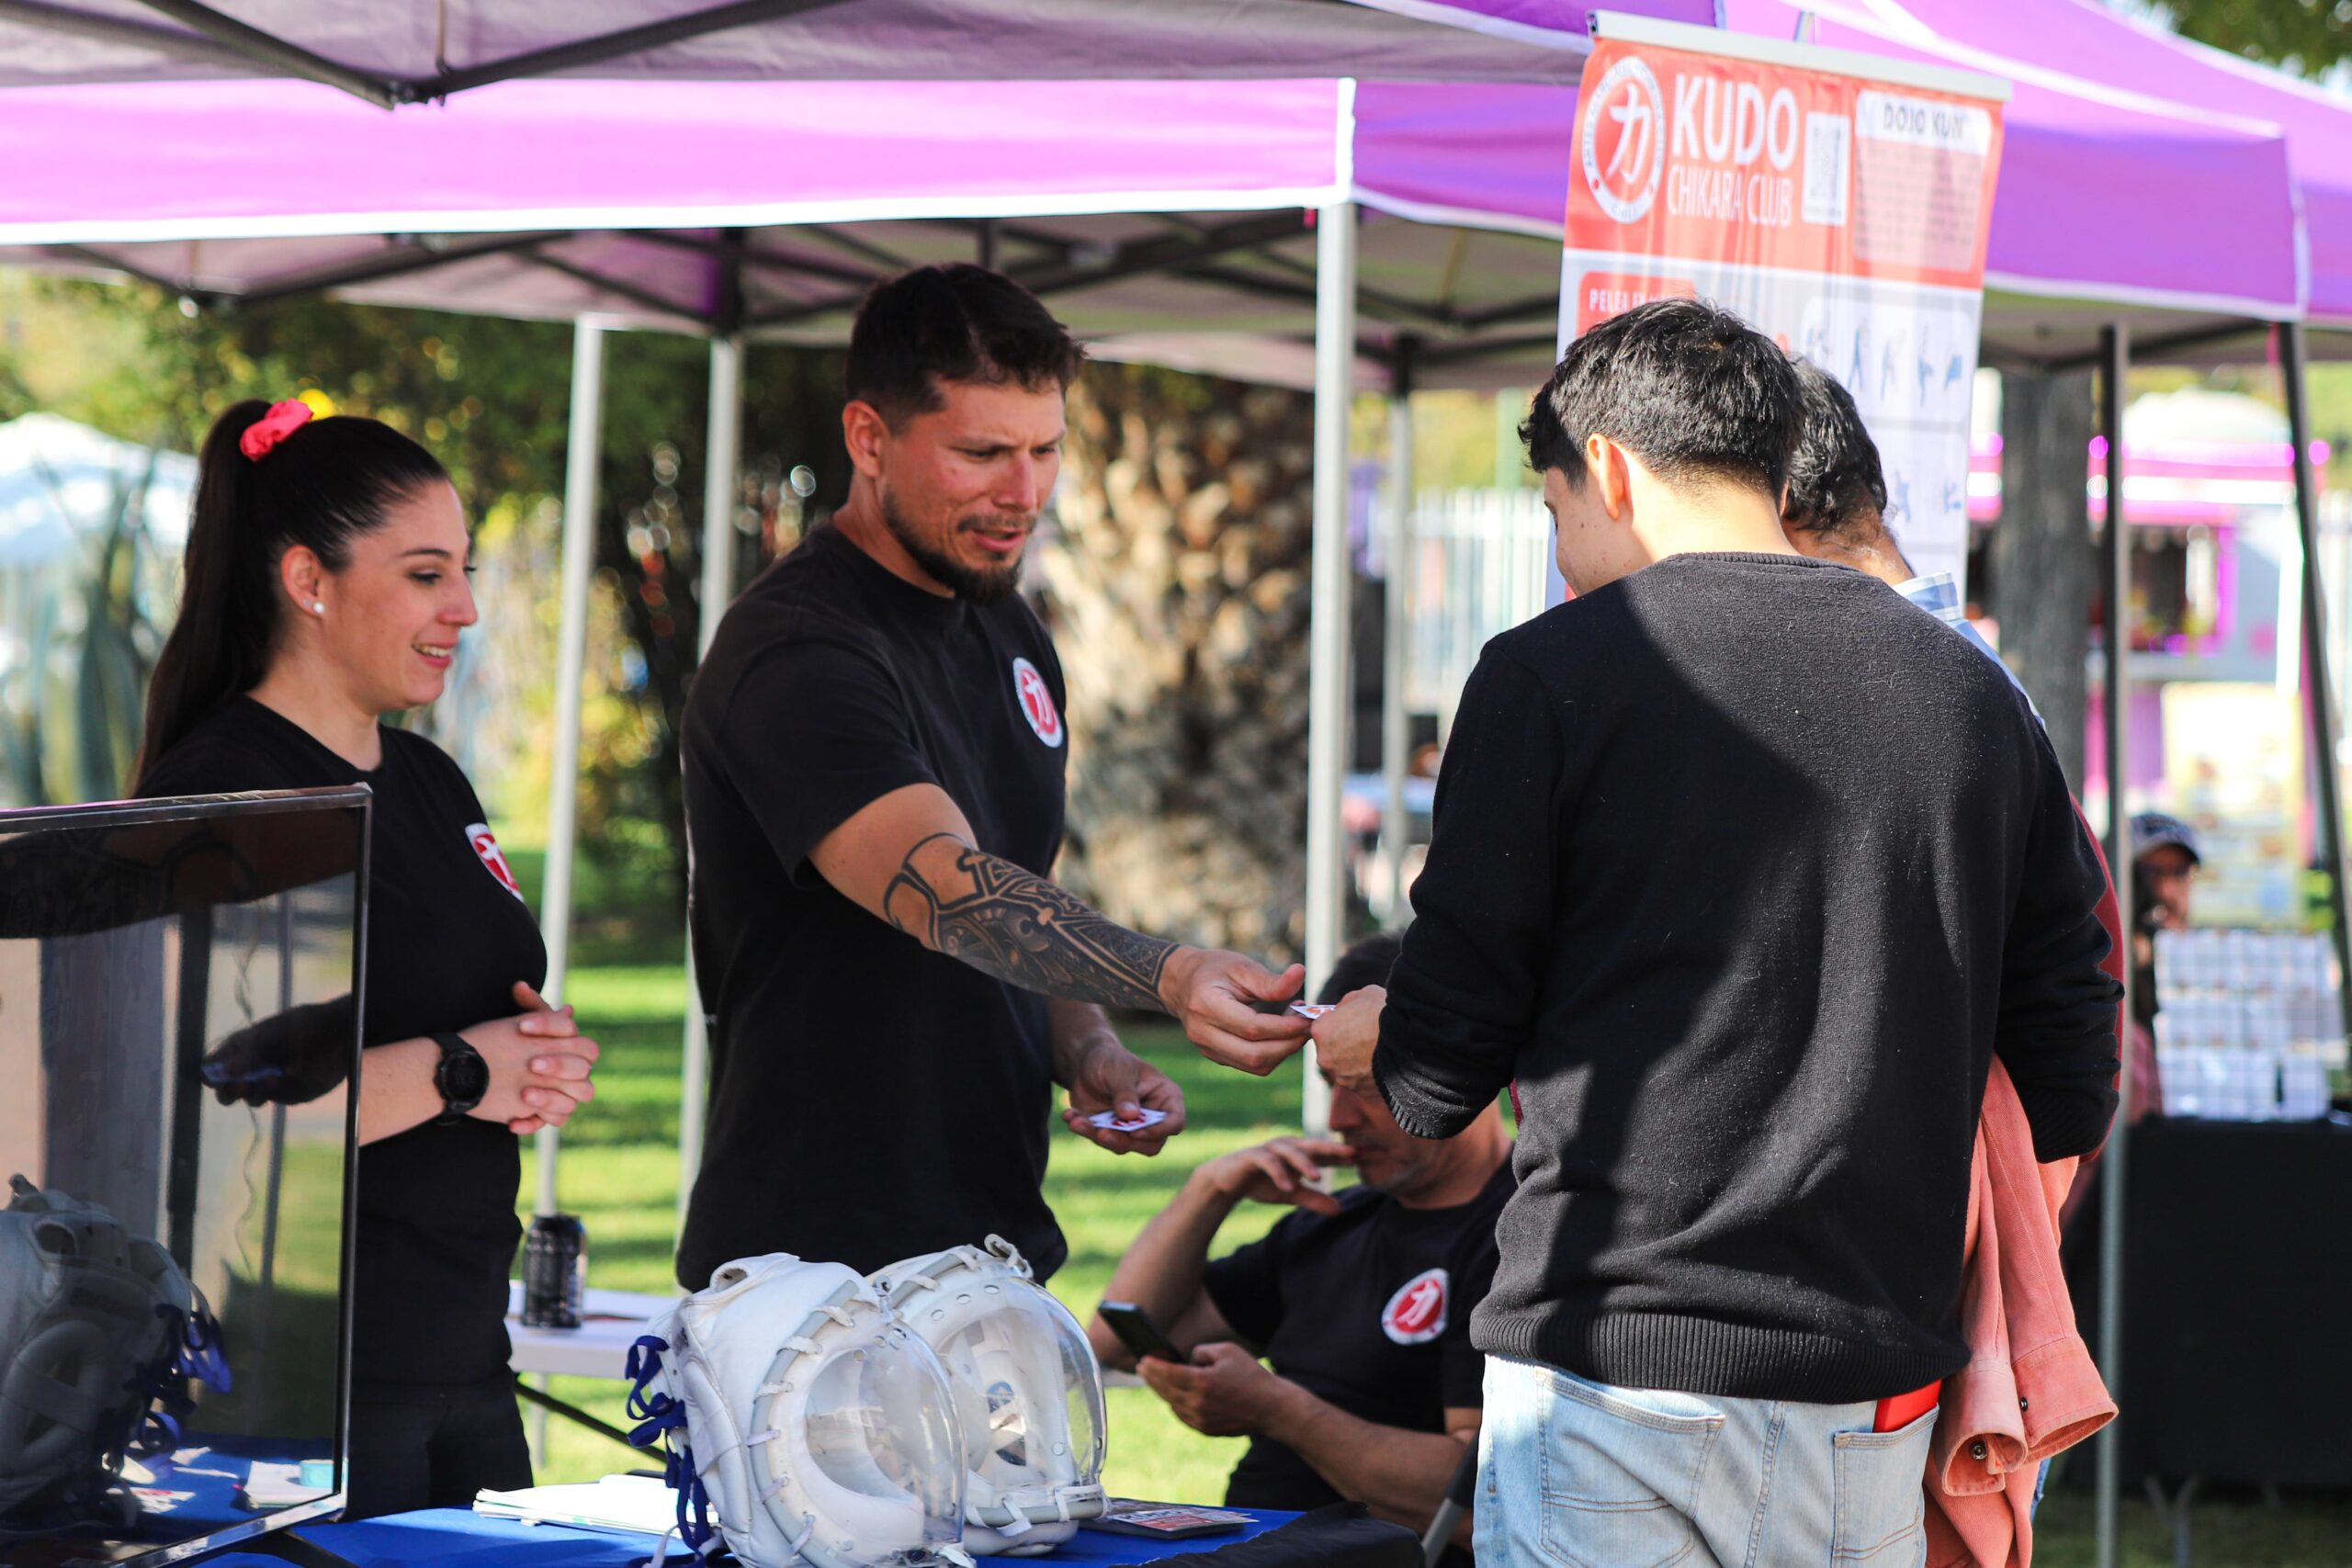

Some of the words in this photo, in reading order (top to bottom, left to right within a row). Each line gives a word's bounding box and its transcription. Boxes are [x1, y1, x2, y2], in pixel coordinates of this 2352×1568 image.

[1672, 74, 1798, 170] KUDO
[1883, 103, 1926, 134] DOJO
[1931, 109, 1965, 140] KUN
[1668, 164, 1743, 222] CHIKARA
[1747, 175, 1793, 228] CLUB
